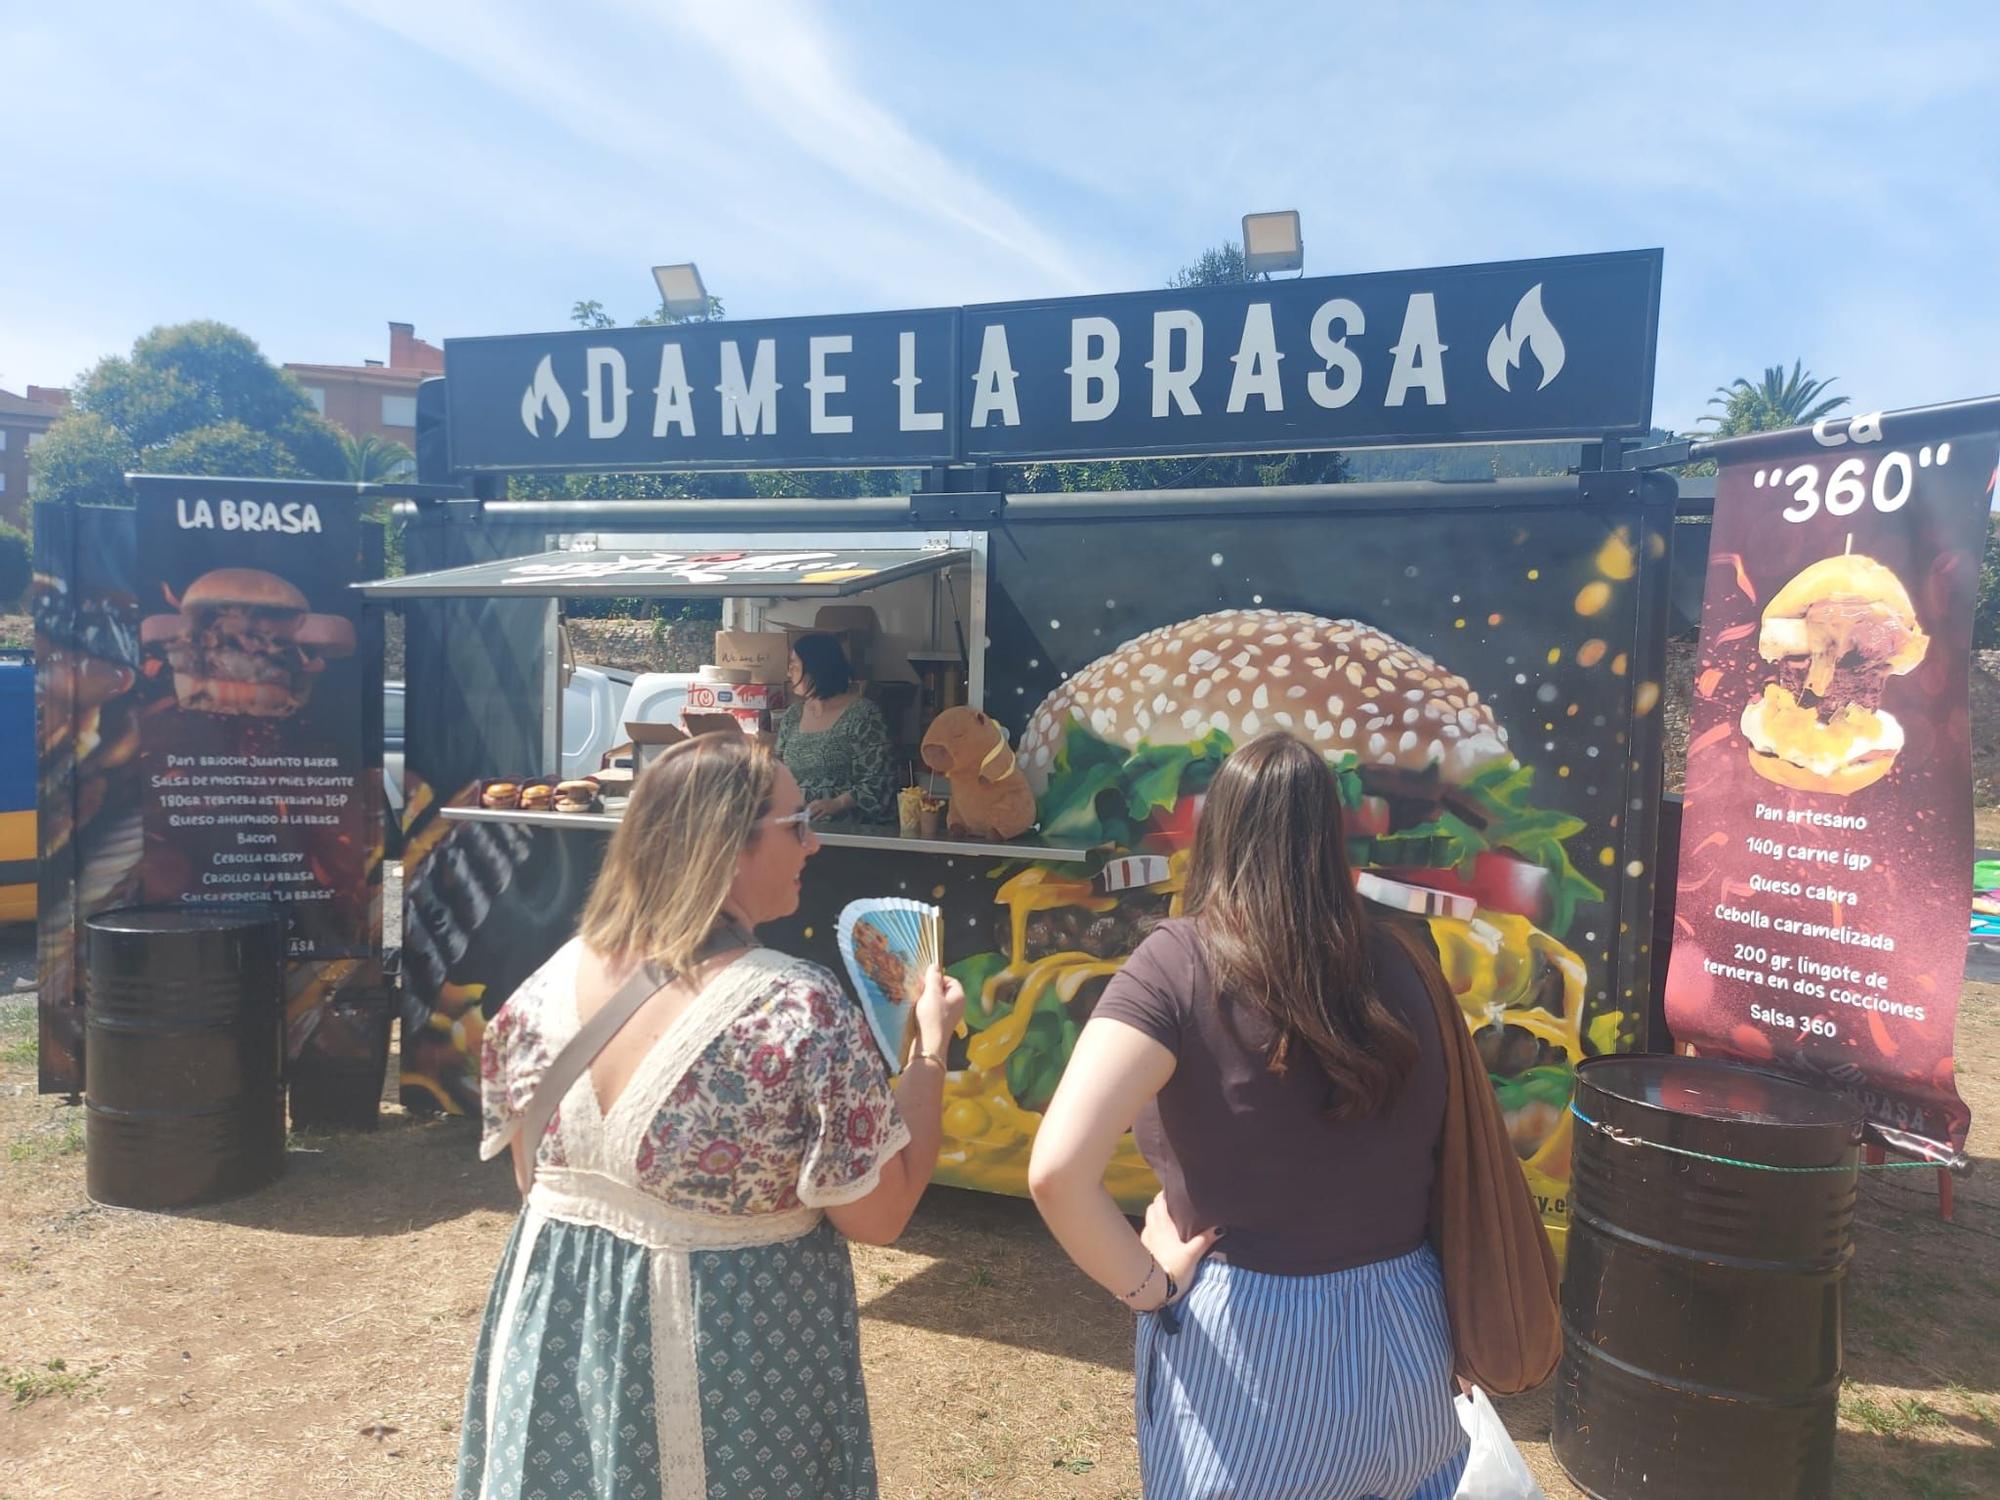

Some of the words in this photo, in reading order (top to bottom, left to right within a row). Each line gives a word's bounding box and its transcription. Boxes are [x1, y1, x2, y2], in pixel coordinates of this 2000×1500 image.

[582, 336, 853, 439] DAME
[892, 325, 1021, 432] LA
[1064, 293, 1449, 422] BRASA
[1753, 442, 1950, 523] "360"
[177, 498, 215, 530] LA
[220, 500, 322, 534] BRASA
[1755, 803, 1782, 821] Pan
[1787, 808, 1867, 830] artesano
[1746, 837, 1783, 860] 140g
[1787, 845, 1839, 864] carne
[1843, 848, 1872, 871] igp
[1749, 874, 1801, 896] Queso
[1806, 885, 1857, 906] cabra
[1715, 904, 1770, 929] Cebolla
[1774, 917, 1895, 952] caramelizada
[1734, 943, 1767, 964] 200
[1770, 954, 1793, 972] gr.
[1798, 956, 1861, 984] lingote
[1865, 972, 1888, 990] de
[1703, 957, 1764, 985] ternera
[1767, 974, 1789, 990] en
[1793, 979, 1825, 999] dos
[1830, 988, 1925, 1022] cocciones
[1750, 1004, 1795, 1029] Salsa
[1799, 1016, 1837, 1038] 360
